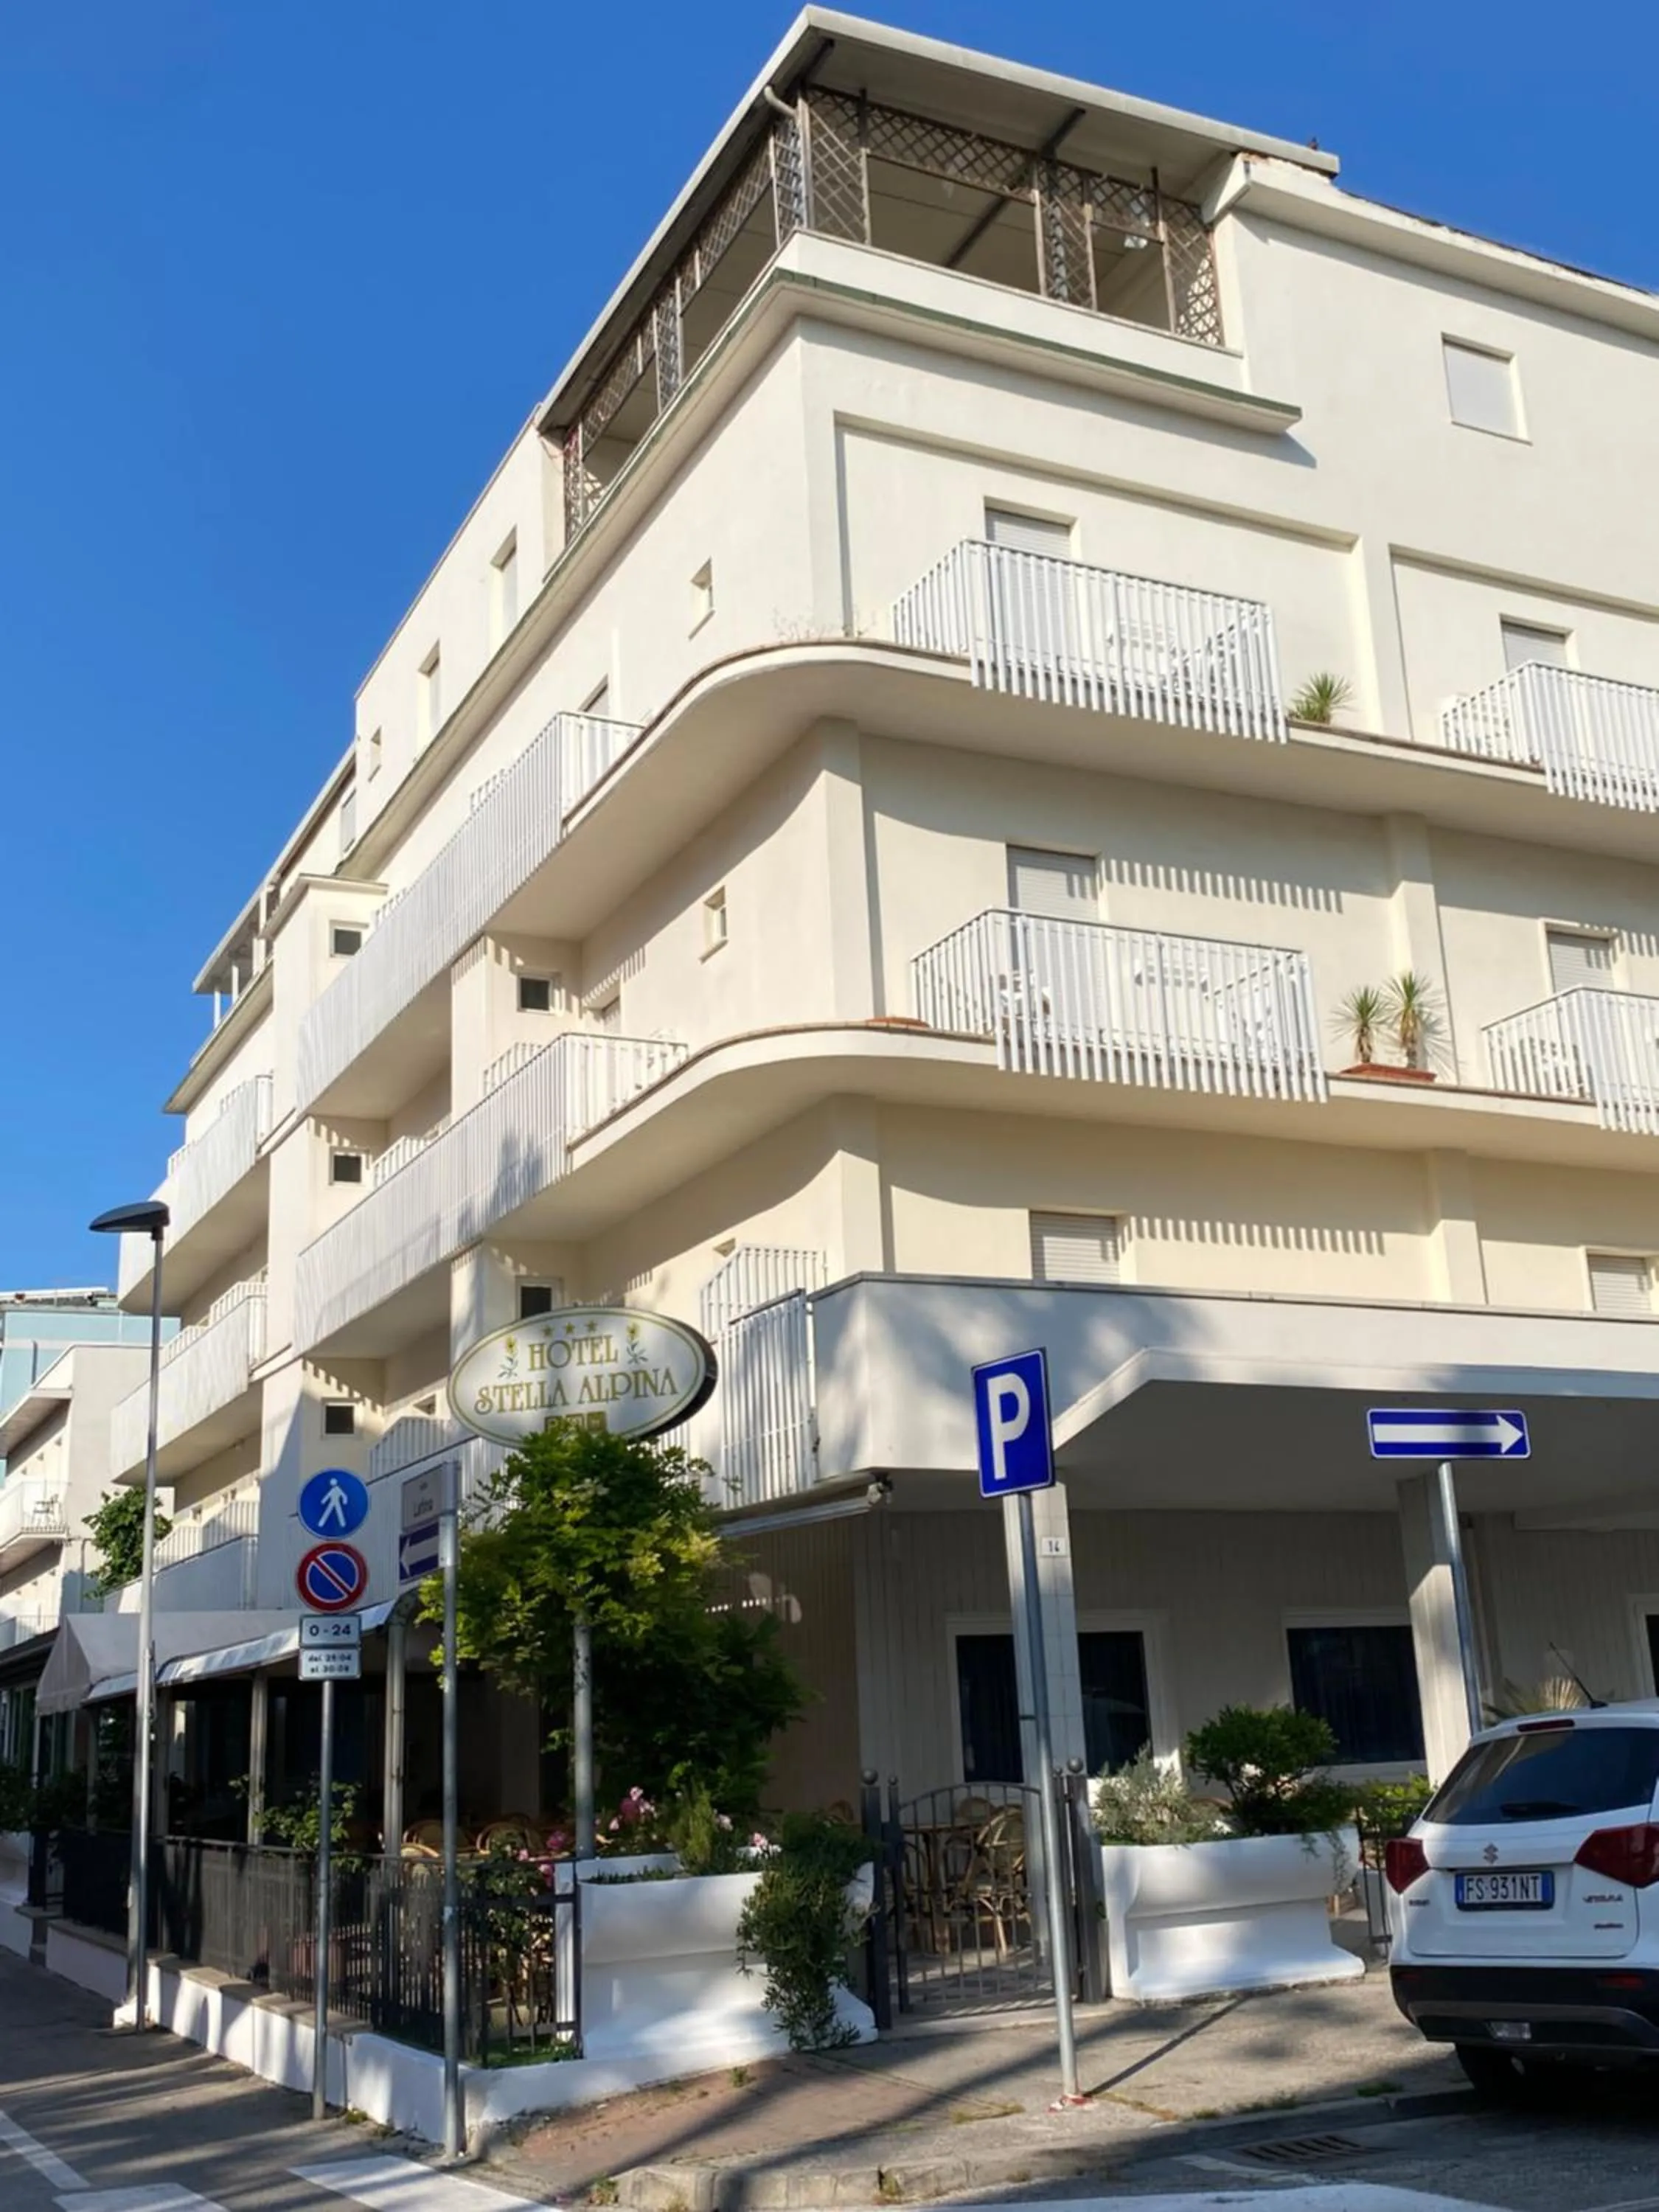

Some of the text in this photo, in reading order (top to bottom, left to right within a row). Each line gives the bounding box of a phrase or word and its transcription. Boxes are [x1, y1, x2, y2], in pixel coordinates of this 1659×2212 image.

[528, 1335, 617, 1371] HOTEL
[473, 1367, 679, 1416] STELLA ALPINA
[987, 1372, 1030, 1481] P
[310, 1624, 319, 1637] 0
[331, 1624, 351, 1636] 24
